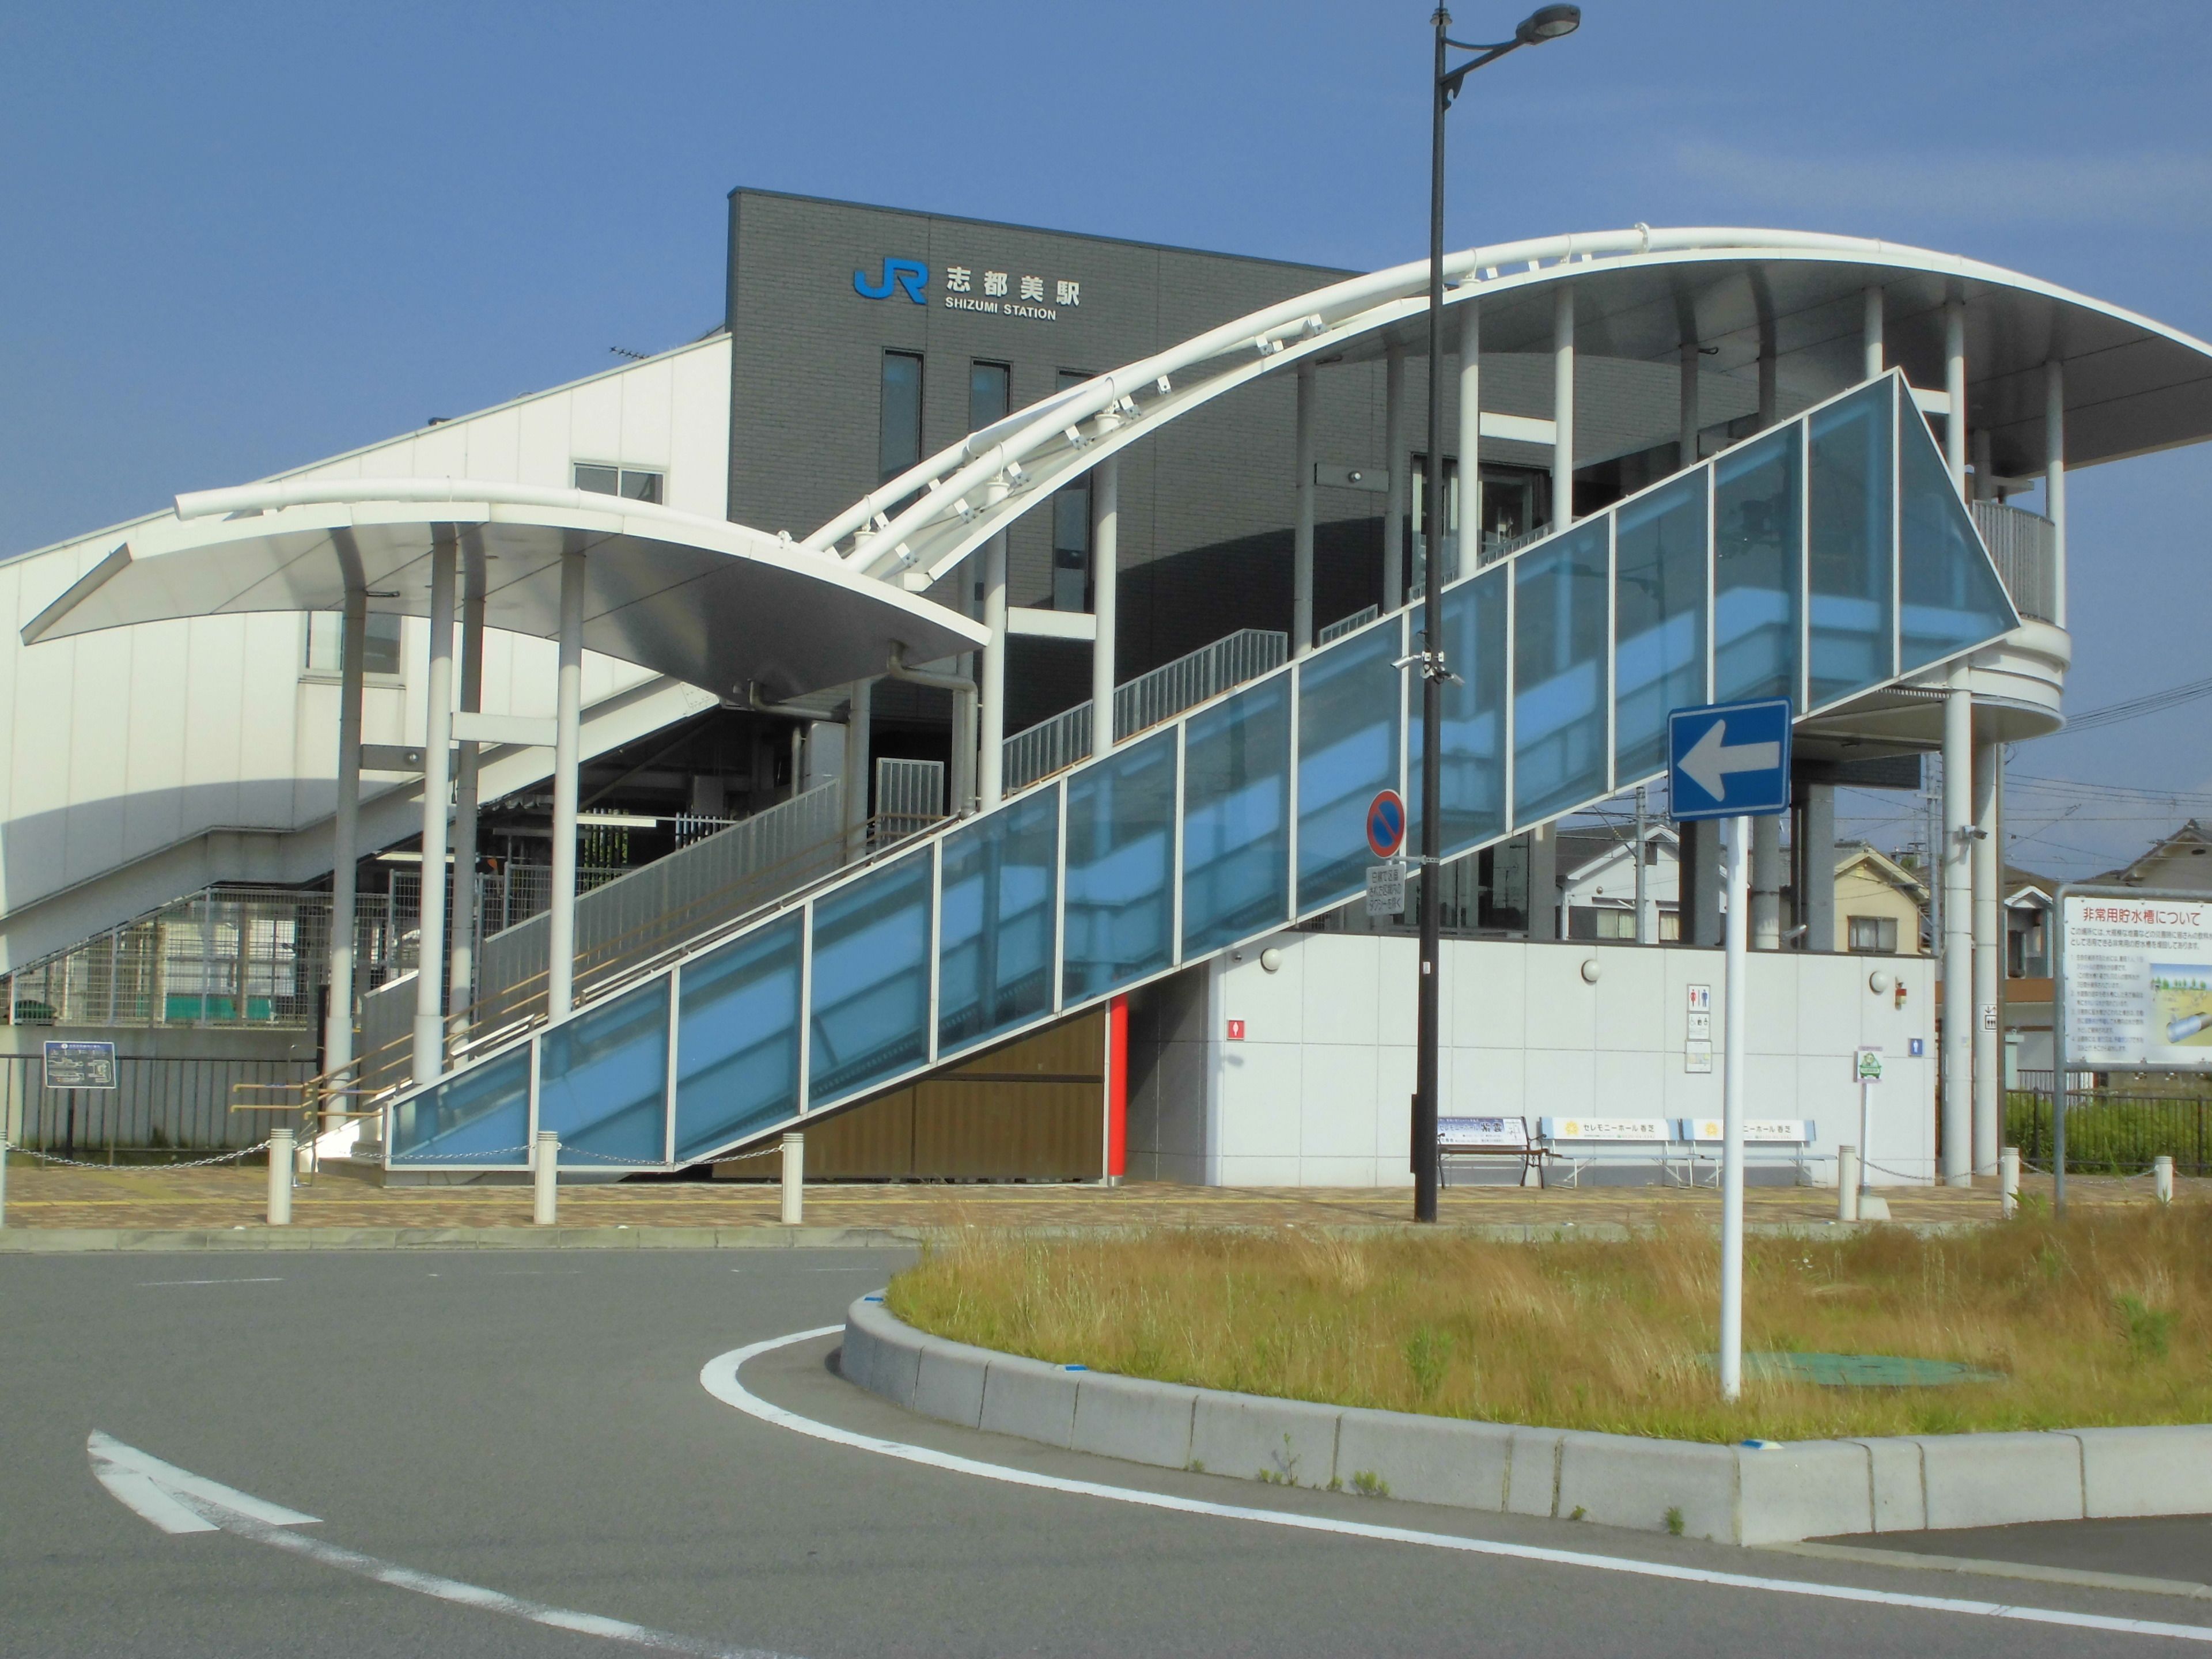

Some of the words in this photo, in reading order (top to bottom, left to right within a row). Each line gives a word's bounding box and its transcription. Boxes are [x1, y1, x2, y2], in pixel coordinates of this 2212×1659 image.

[854, 257, 929, 305] JR
[946, 266, 1081, 306] 志都美駅
[945, 296, 998, 314] SHIZUMI
[1003, 304, 1056, 321] STATION
[2083, 907, 2201, 926] 非常用貯水槽について
[1641, 1124, 1655, 1132] 香芝
[1743, 1125, 1775, 1133] ニーホール
